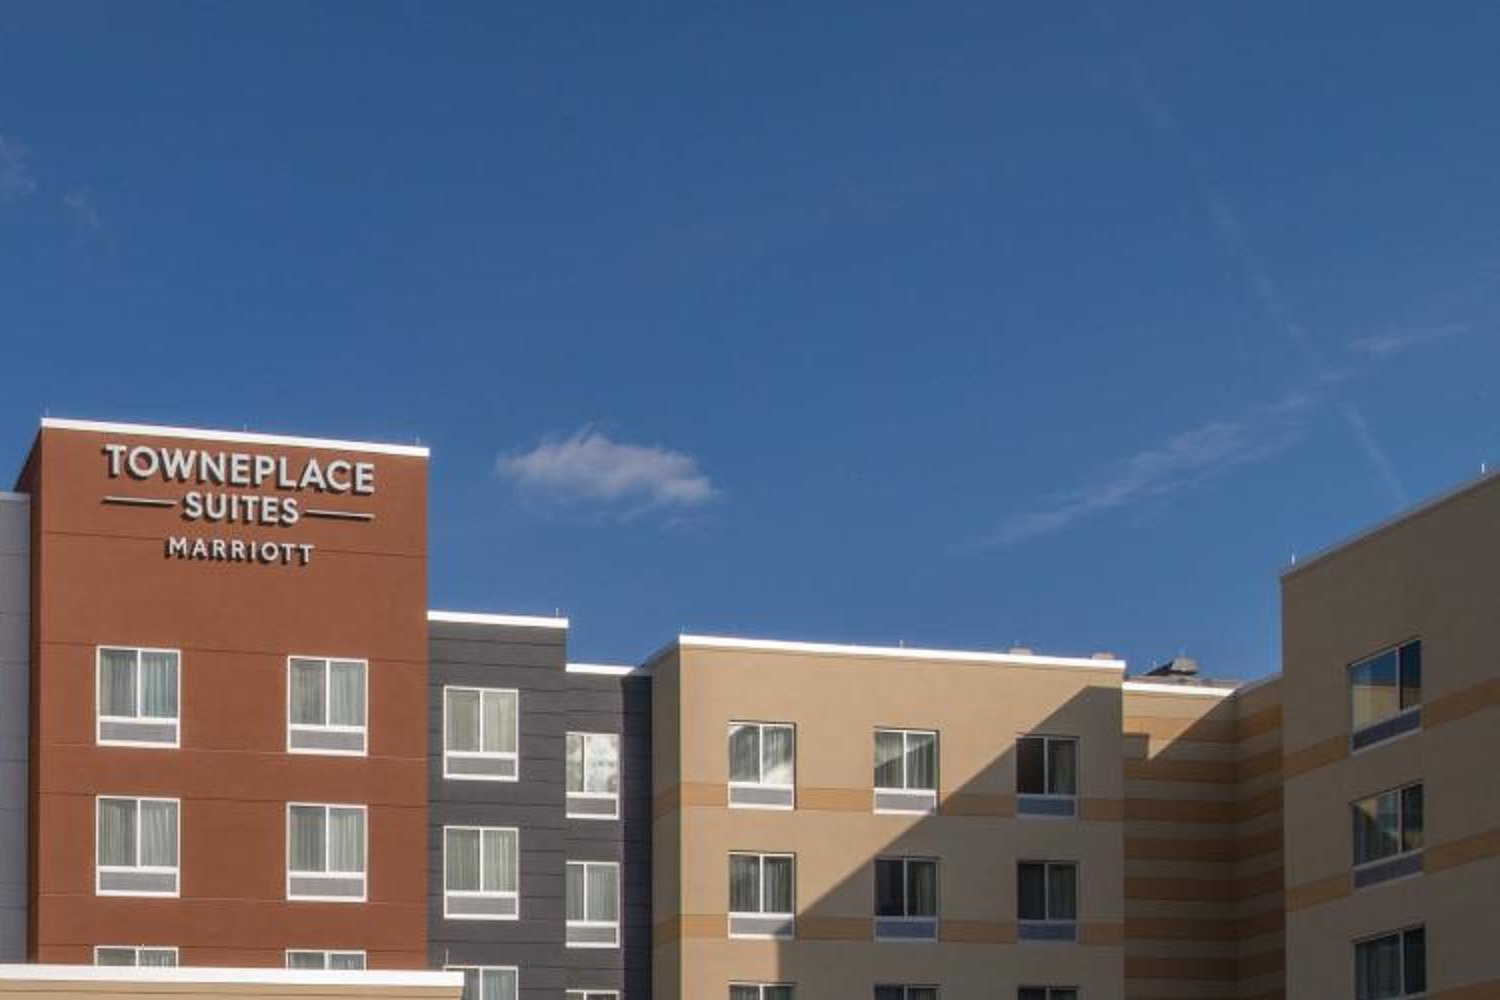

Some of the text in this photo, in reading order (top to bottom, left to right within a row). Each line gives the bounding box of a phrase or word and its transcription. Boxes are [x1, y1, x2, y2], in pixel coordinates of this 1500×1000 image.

[104, 443, 376, 494] TOWNEPLACE
[183, 491, 300, 524] SUITES
[167, 536, 315, 564] MARRIOTT
